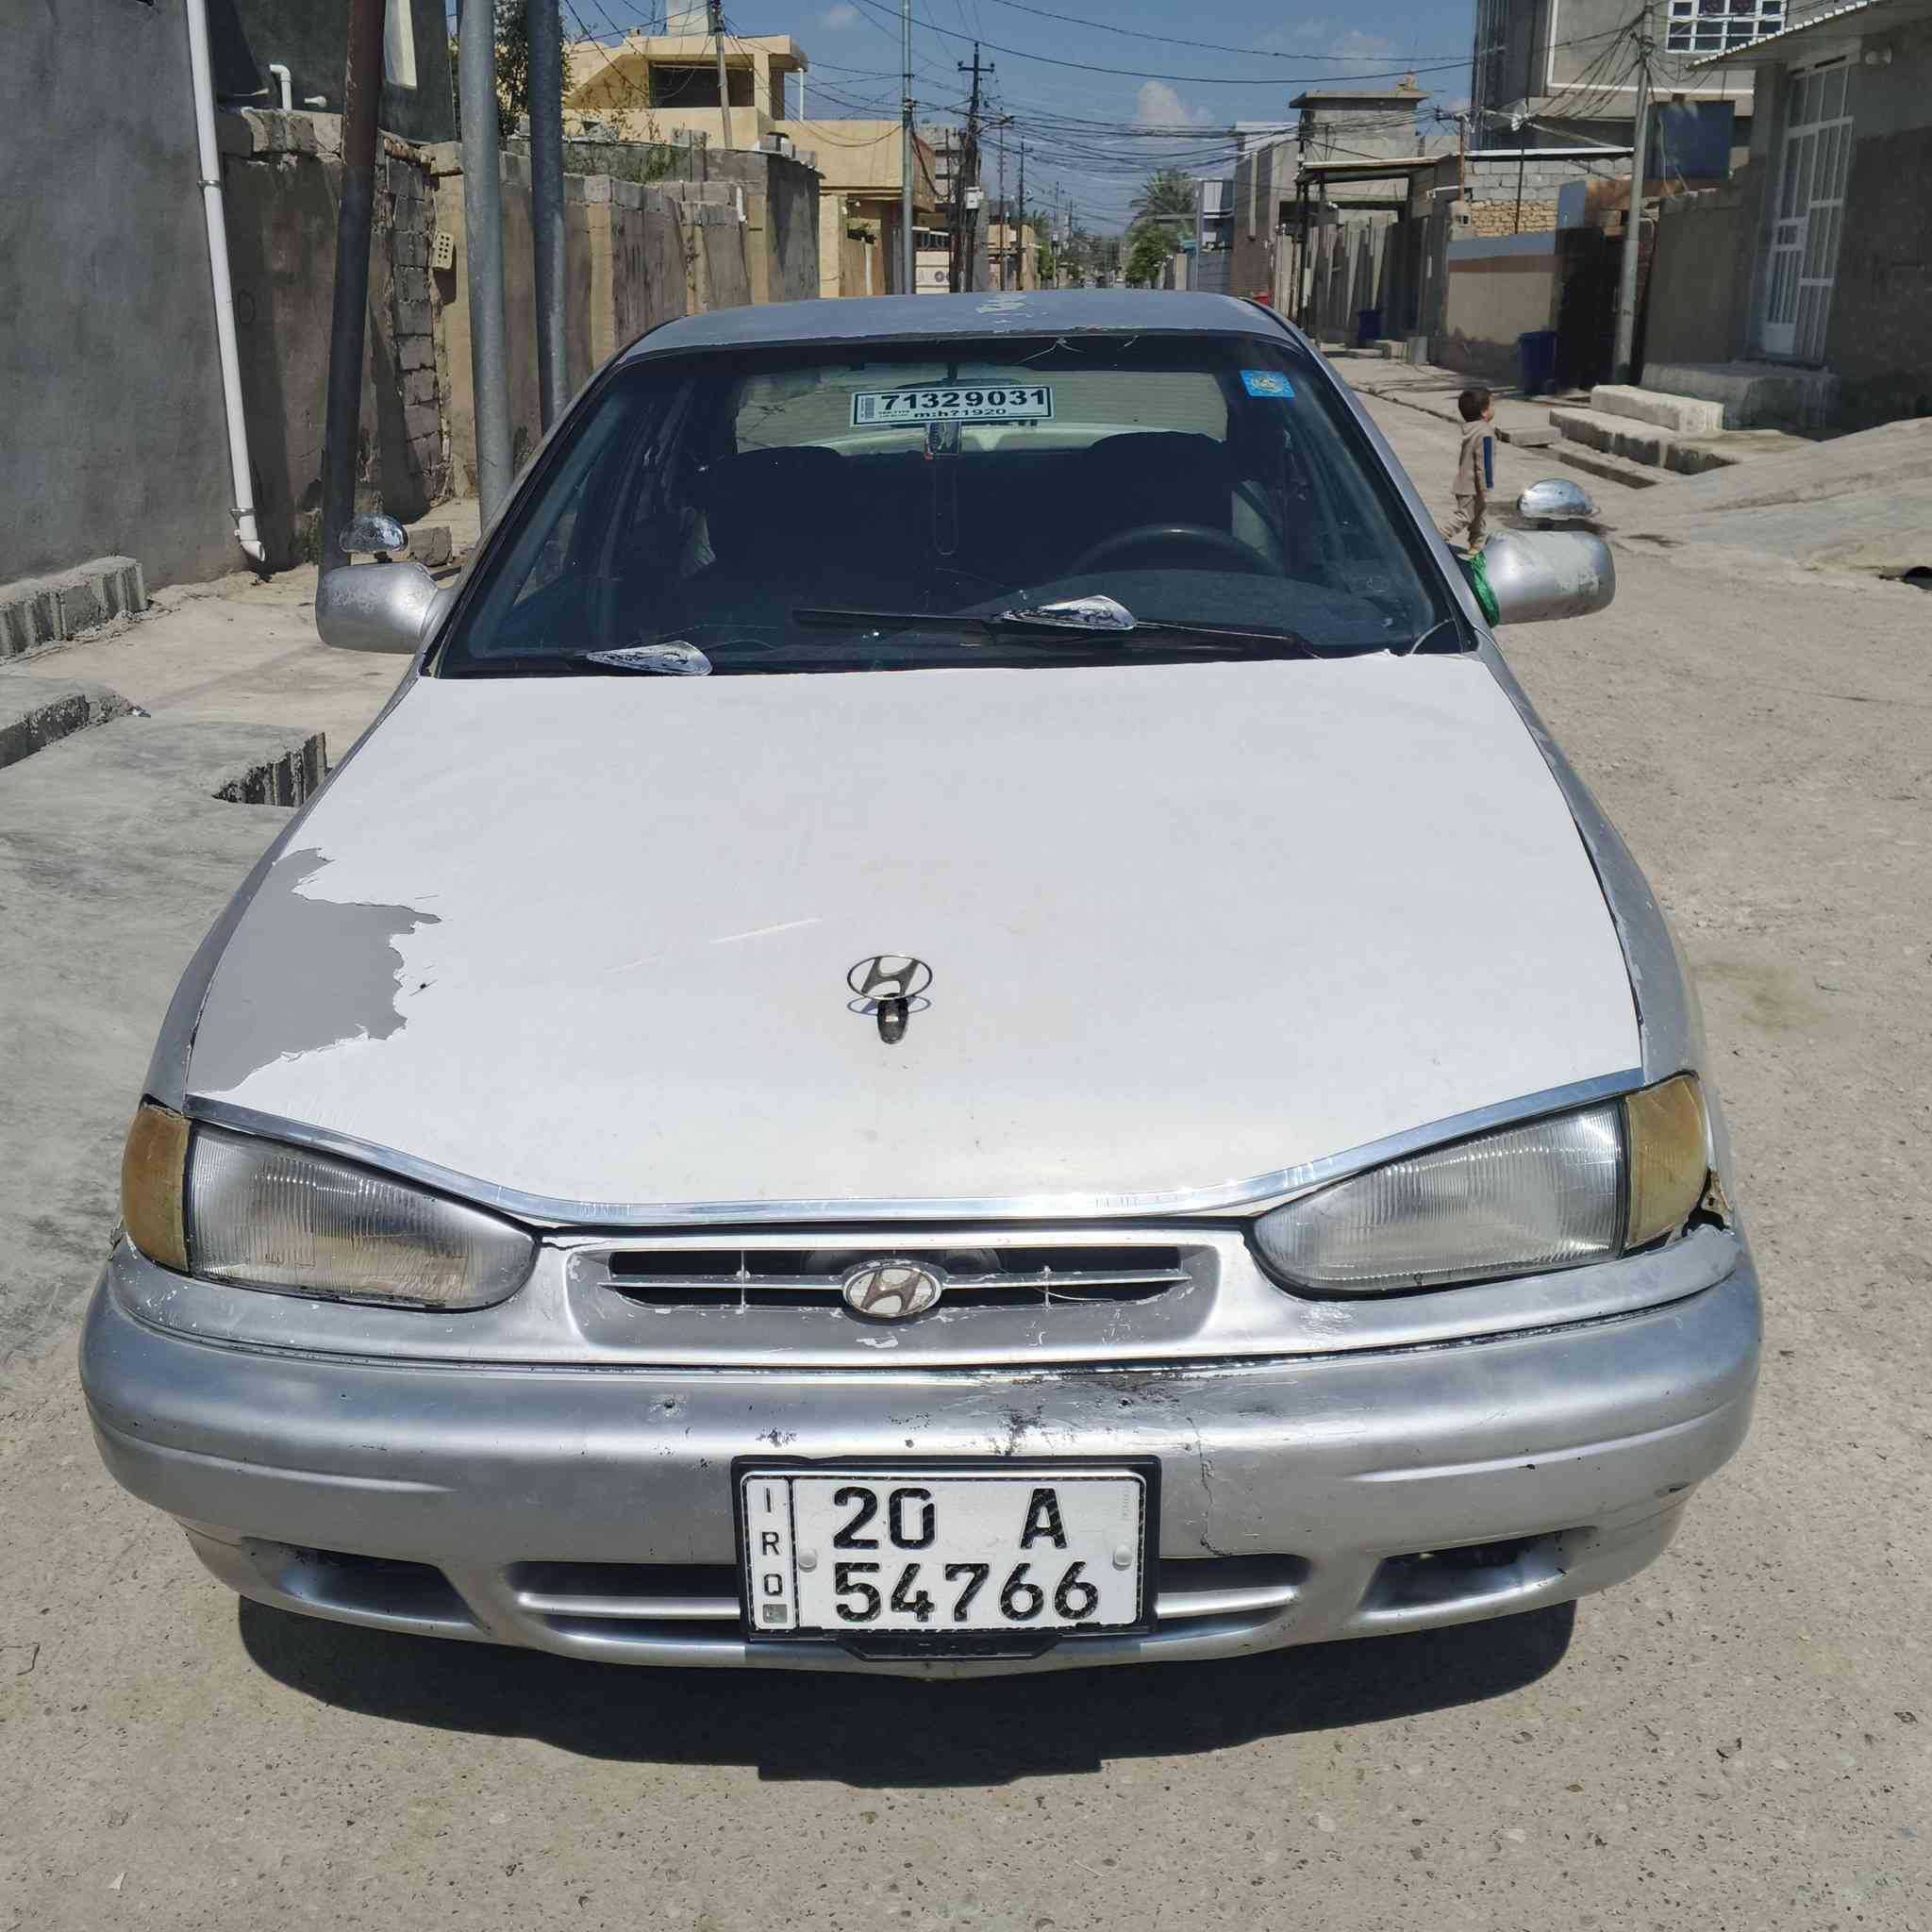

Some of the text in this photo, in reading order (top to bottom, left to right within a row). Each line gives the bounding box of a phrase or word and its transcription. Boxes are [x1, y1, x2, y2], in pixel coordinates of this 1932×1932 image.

[880, 390, 1045, 410] 71329031
[833, 1487, 937, 1550] 20
[1019, 1488, 1069, 1550] A
[834, 1560, 1099, 1623] 54766
